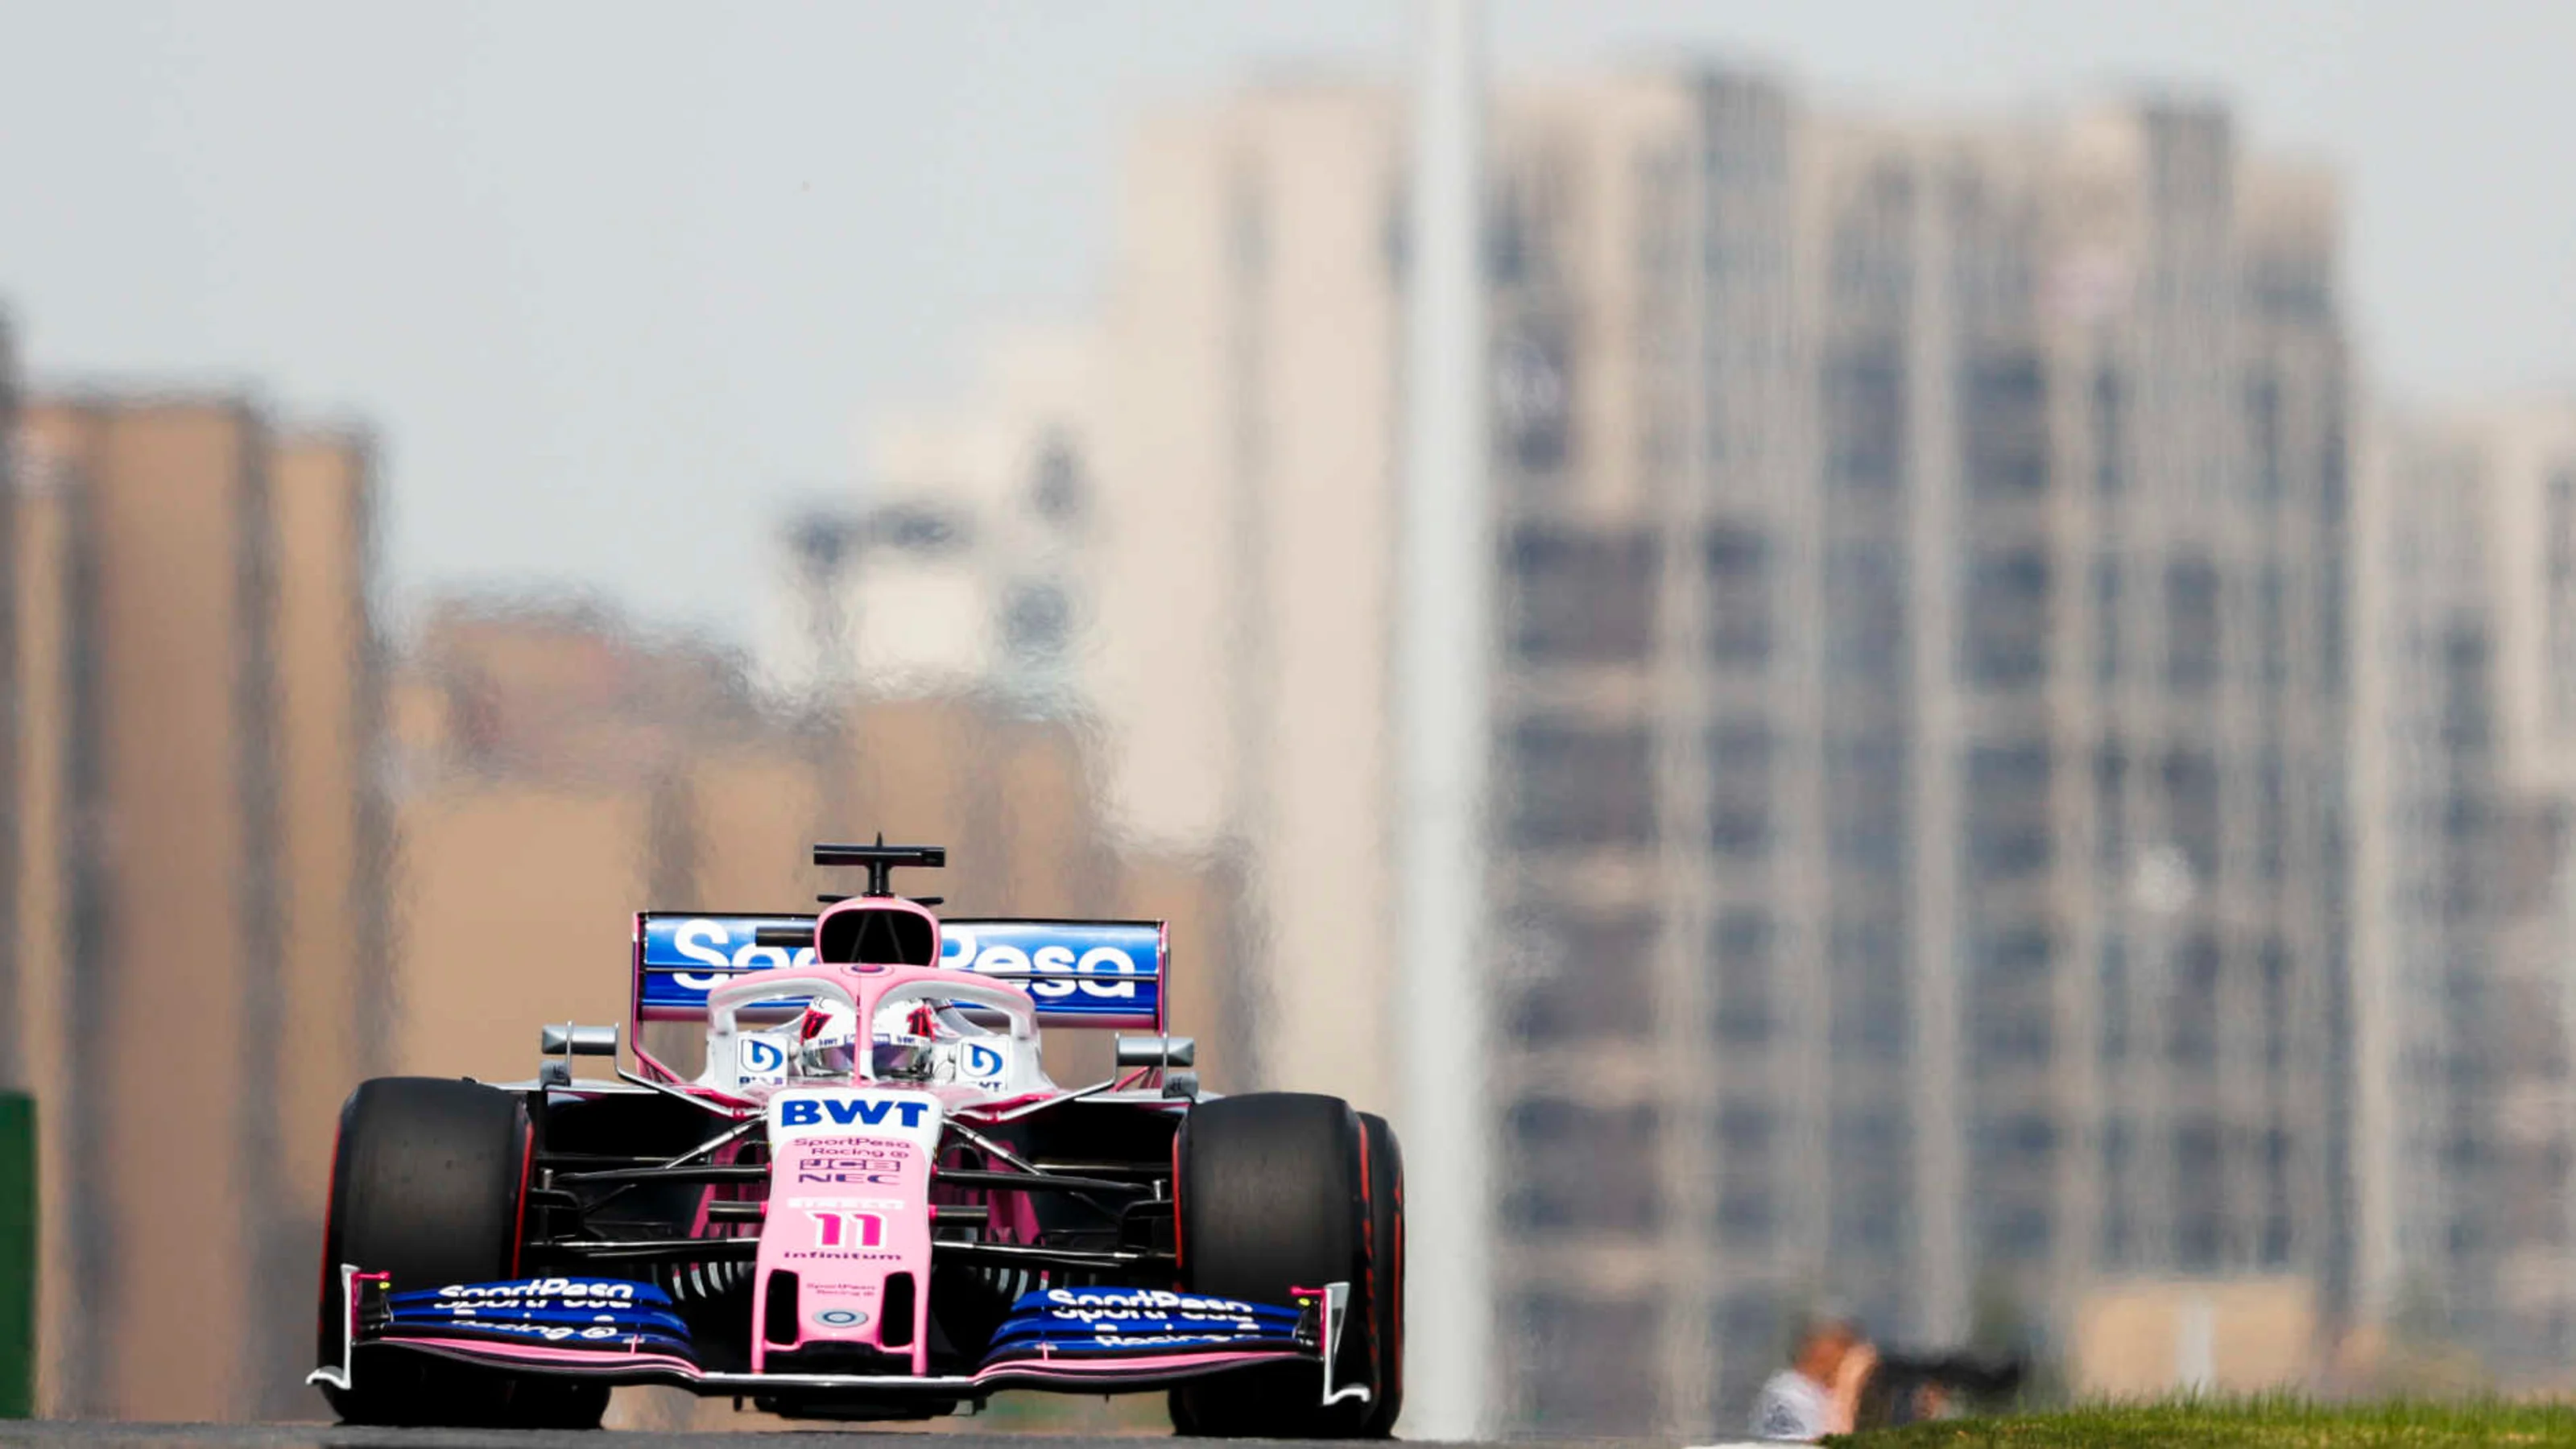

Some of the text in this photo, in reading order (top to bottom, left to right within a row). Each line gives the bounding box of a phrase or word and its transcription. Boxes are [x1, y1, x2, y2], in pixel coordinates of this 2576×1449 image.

[781, 1100, 929, 1127] BWT
[793, 1137, 911, 1149] SportPesa
[811, 1147, 885, 1158] Racing
[798, 1174, 901, 1185] NEC
[804, 1211, 886, 1249] 11
[784, 1251, 902, 1261] infinitum
